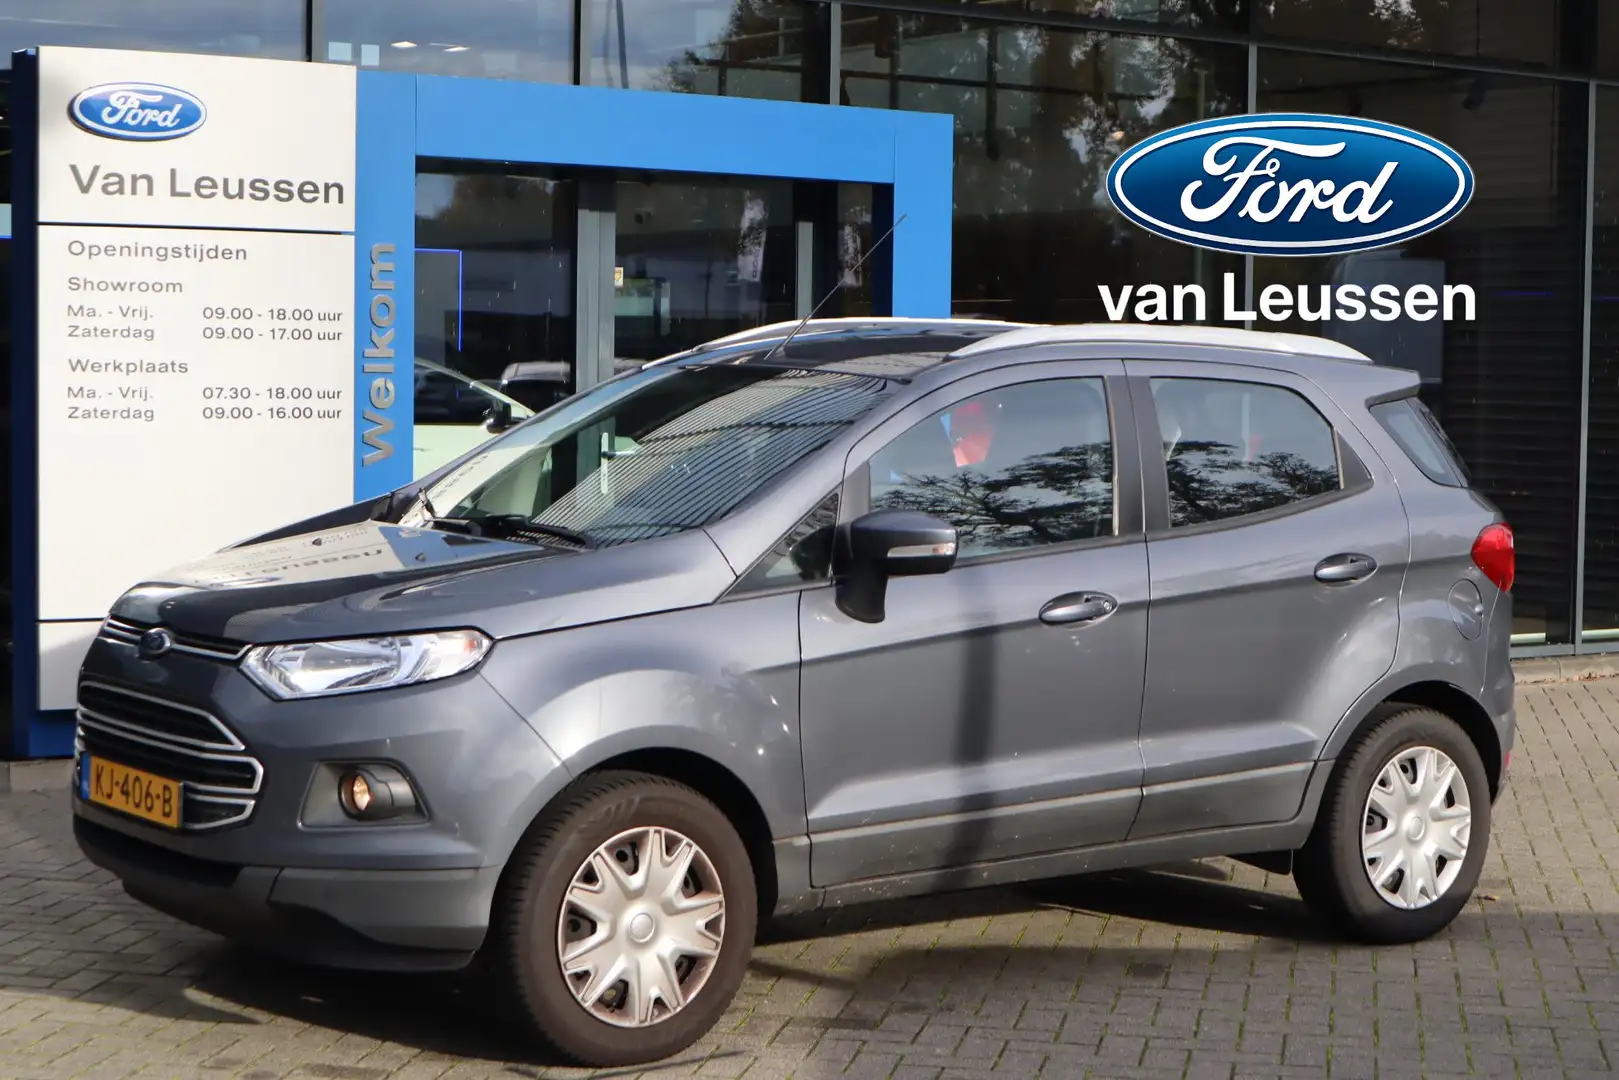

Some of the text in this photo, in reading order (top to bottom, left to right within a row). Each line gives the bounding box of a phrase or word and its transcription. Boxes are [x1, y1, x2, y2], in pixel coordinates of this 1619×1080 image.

[101, 90, 182, 128] Ford
[68, 163, 344, 205] Van Leussen
[67, 240, 247, 263] Openingstijden
[67, 276, 183, 293] Showroom
[67, 304, 102, 318] Ma.
[118, 305, 154, 322] Vrij.
[202, 306, 254, 321] 09.00
[268, 307, 314, 322] 18.00
[317, 312, 343, 322] uur
[67, 325, 155, 342] Zaterdag
[202, 326, 254, 340] 09.00
[269, 327, 313, 341] 17.00
[317, 331, 343, 341] uur
[362, 243, 396, 468] Welkom
[68, 358, 189, 376] Werkplaats
[67, 386, 102, 399] Ma.
[118, 386, 154, 402] Vrij.
[202, 386, 252, 400] 07.30
[266, 386, 313, 400] 18.00
[316, 389, 343, 400] uur
[67, 406, 155, 422] Zaterdag
[202, 406, 254, 420] 09.00
[267, 406, 314, 420] 16.00
[317, 409, 343, 420] uur
[95, 763, 172, 818] KJ-406-B
